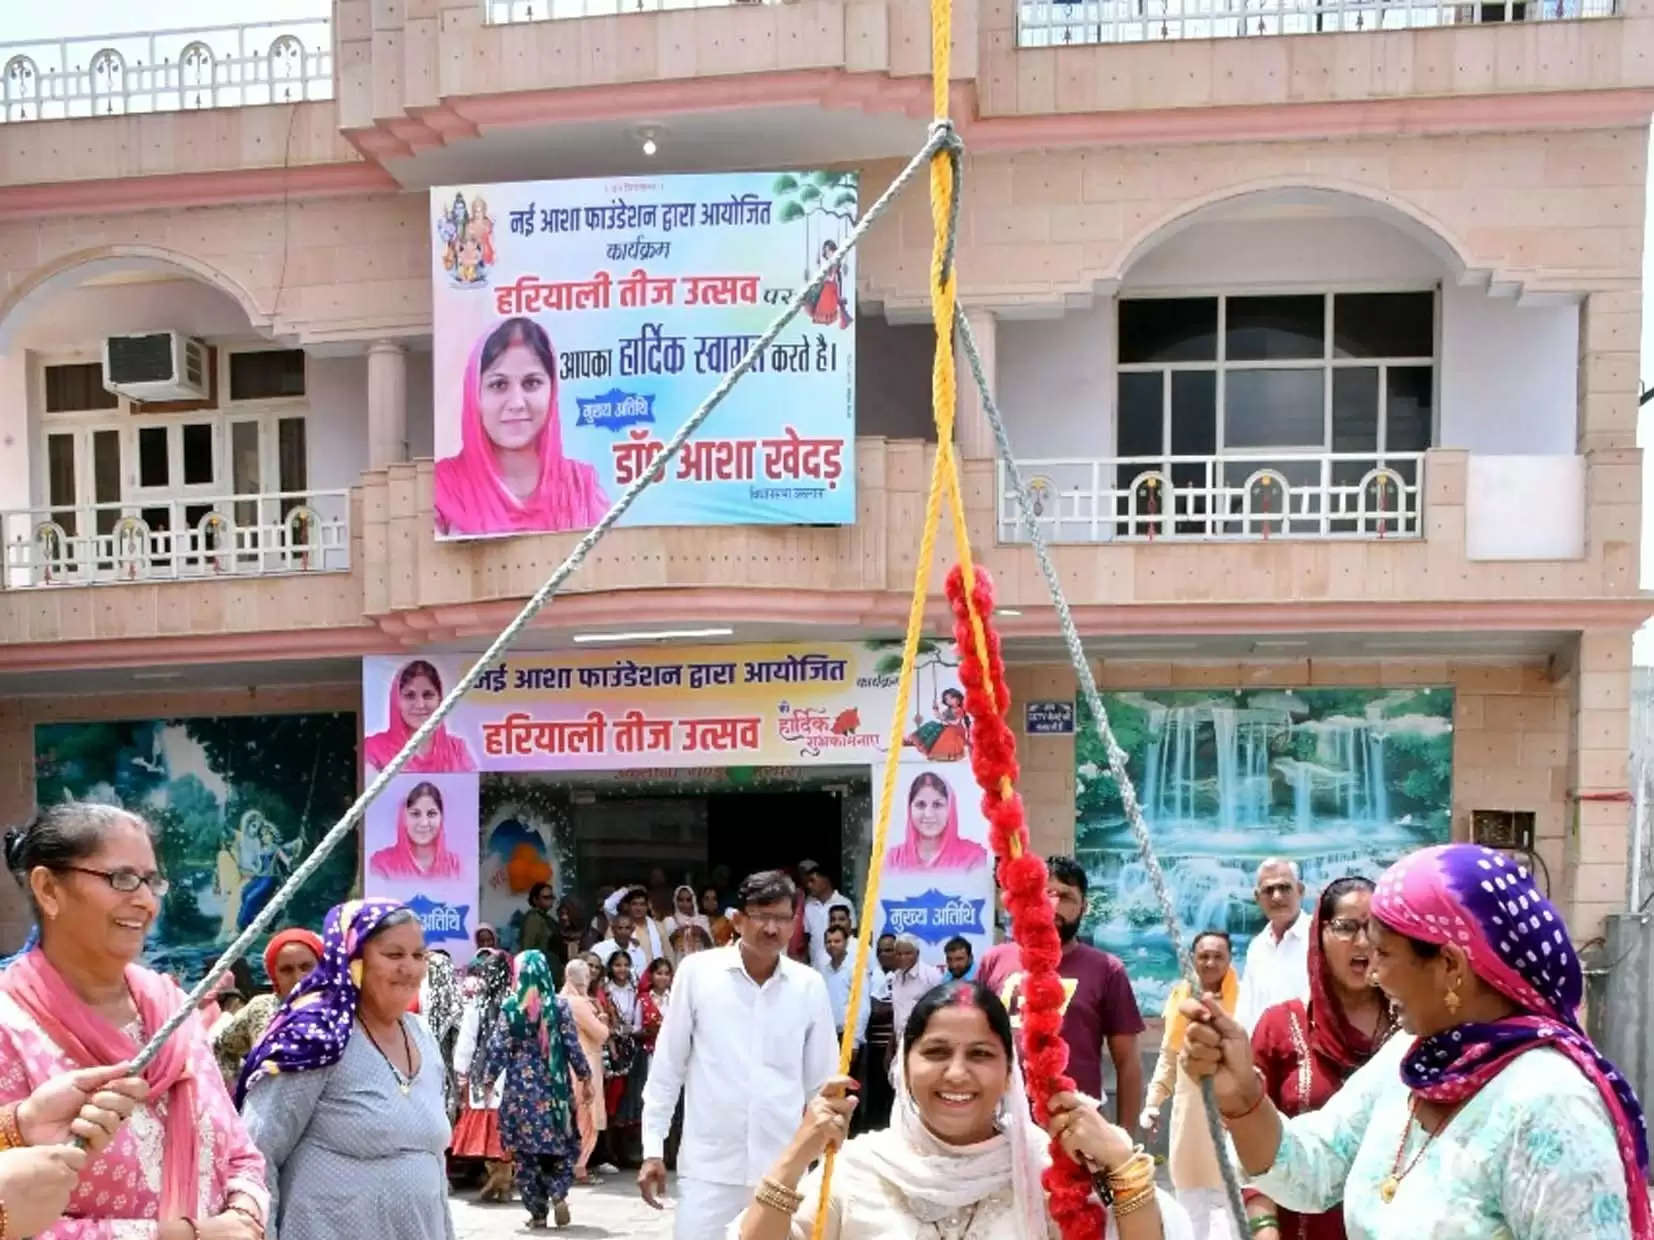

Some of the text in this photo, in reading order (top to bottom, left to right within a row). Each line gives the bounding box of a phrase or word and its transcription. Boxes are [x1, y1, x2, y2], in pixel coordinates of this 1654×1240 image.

[510, 194, 772, 237] नई आशा फाउंडेशन द्वारा आयोजित
[606, 235, 671, 260] कार्यक्रम
[495, 269, 793, 315] हरियाली तीज उत्सव पर
[560, 349, 613, 380] आपका
[619, 323, 686, 376] हार्दिक
[771, 334, 810, 373] करते
[583, 396, 649, 424] मुख्य अतिथि
[677, 440, 756, 482] आशा
[762, 427, 844, 489] खेदड़
[514, 668, 572, 689] आशा
[577, 660, 683, 688] फाउंडेशन
[688, 664, 736, 688] द्वारा
[744, 654, 847, 682] आयोजित
[483, 711, 761, 754] हरियाली तीज उत्सव
[779, 707, 830, 739] हार्दिक
[889, 900, 976, 933] मुख्य अतिथि
